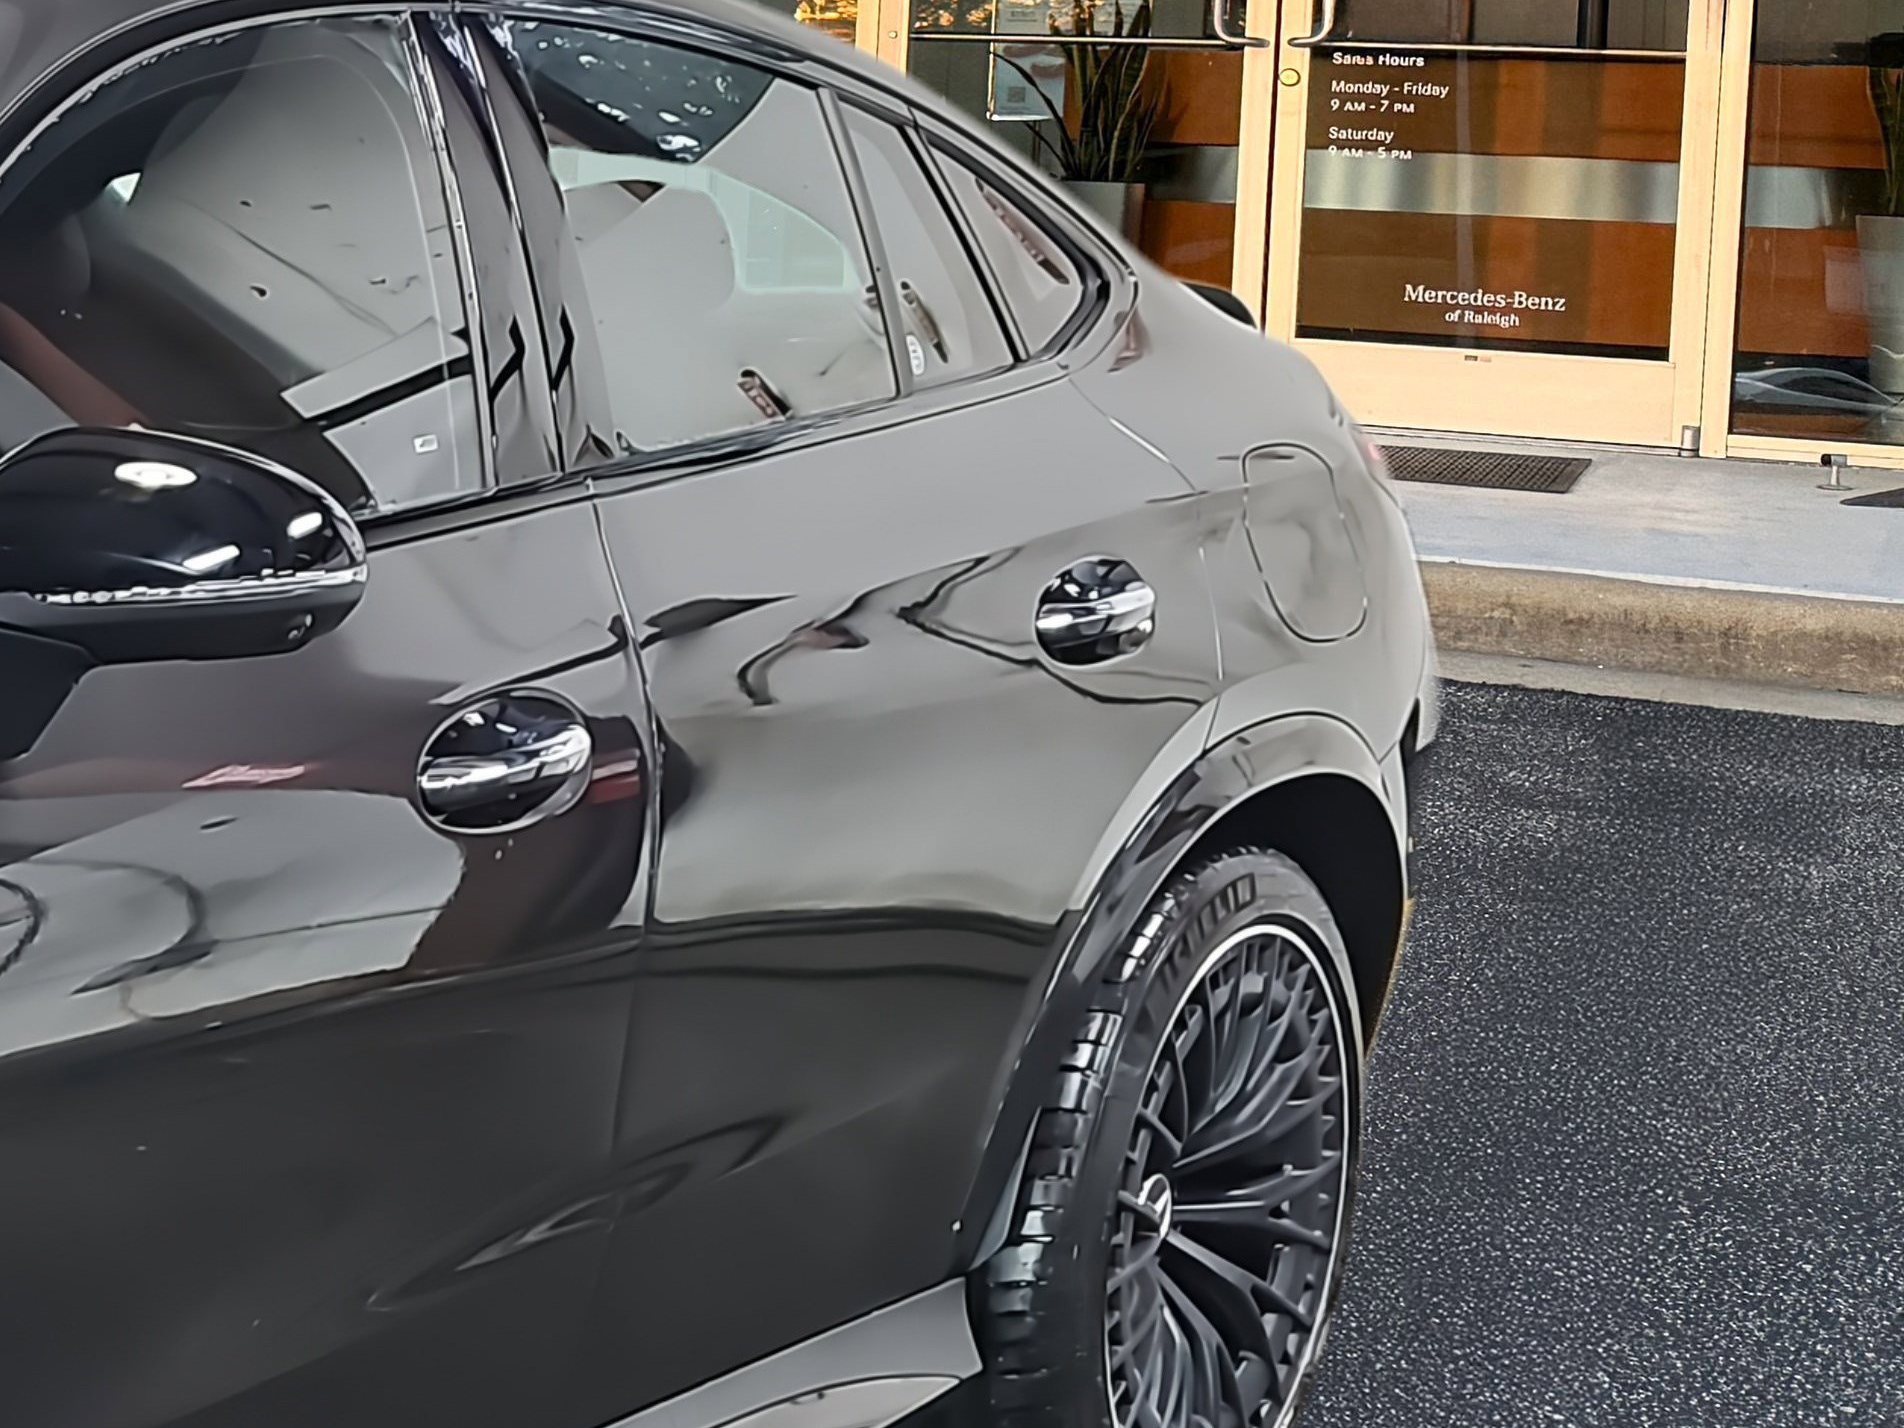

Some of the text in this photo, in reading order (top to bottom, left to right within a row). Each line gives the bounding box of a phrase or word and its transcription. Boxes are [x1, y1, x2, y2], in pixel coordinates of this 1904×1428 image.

[1378, 53, 1425, 67] Hours
[1331, 80, 1390, 97] Monday
[1403, 82, 1449, 99] Friday
[1330, 98, 1340, 111] 9
[1343, 101, 1366, 112] AM
[1380, 99, 1389, 112] 7
[1393, 102, 1415, 113] PM
[1328, 126, 1394, 144] Saturday
[1328, 145, 1338, 158] 9
[1341, 147, 1363, 158] AM
[1377, 146, 1386, 159] 5
[1391, 149, 1413, 160] PM
[1403, 283, 1566, 312] Mercedes-Benz
[1444, 309, 1461, 322] of
